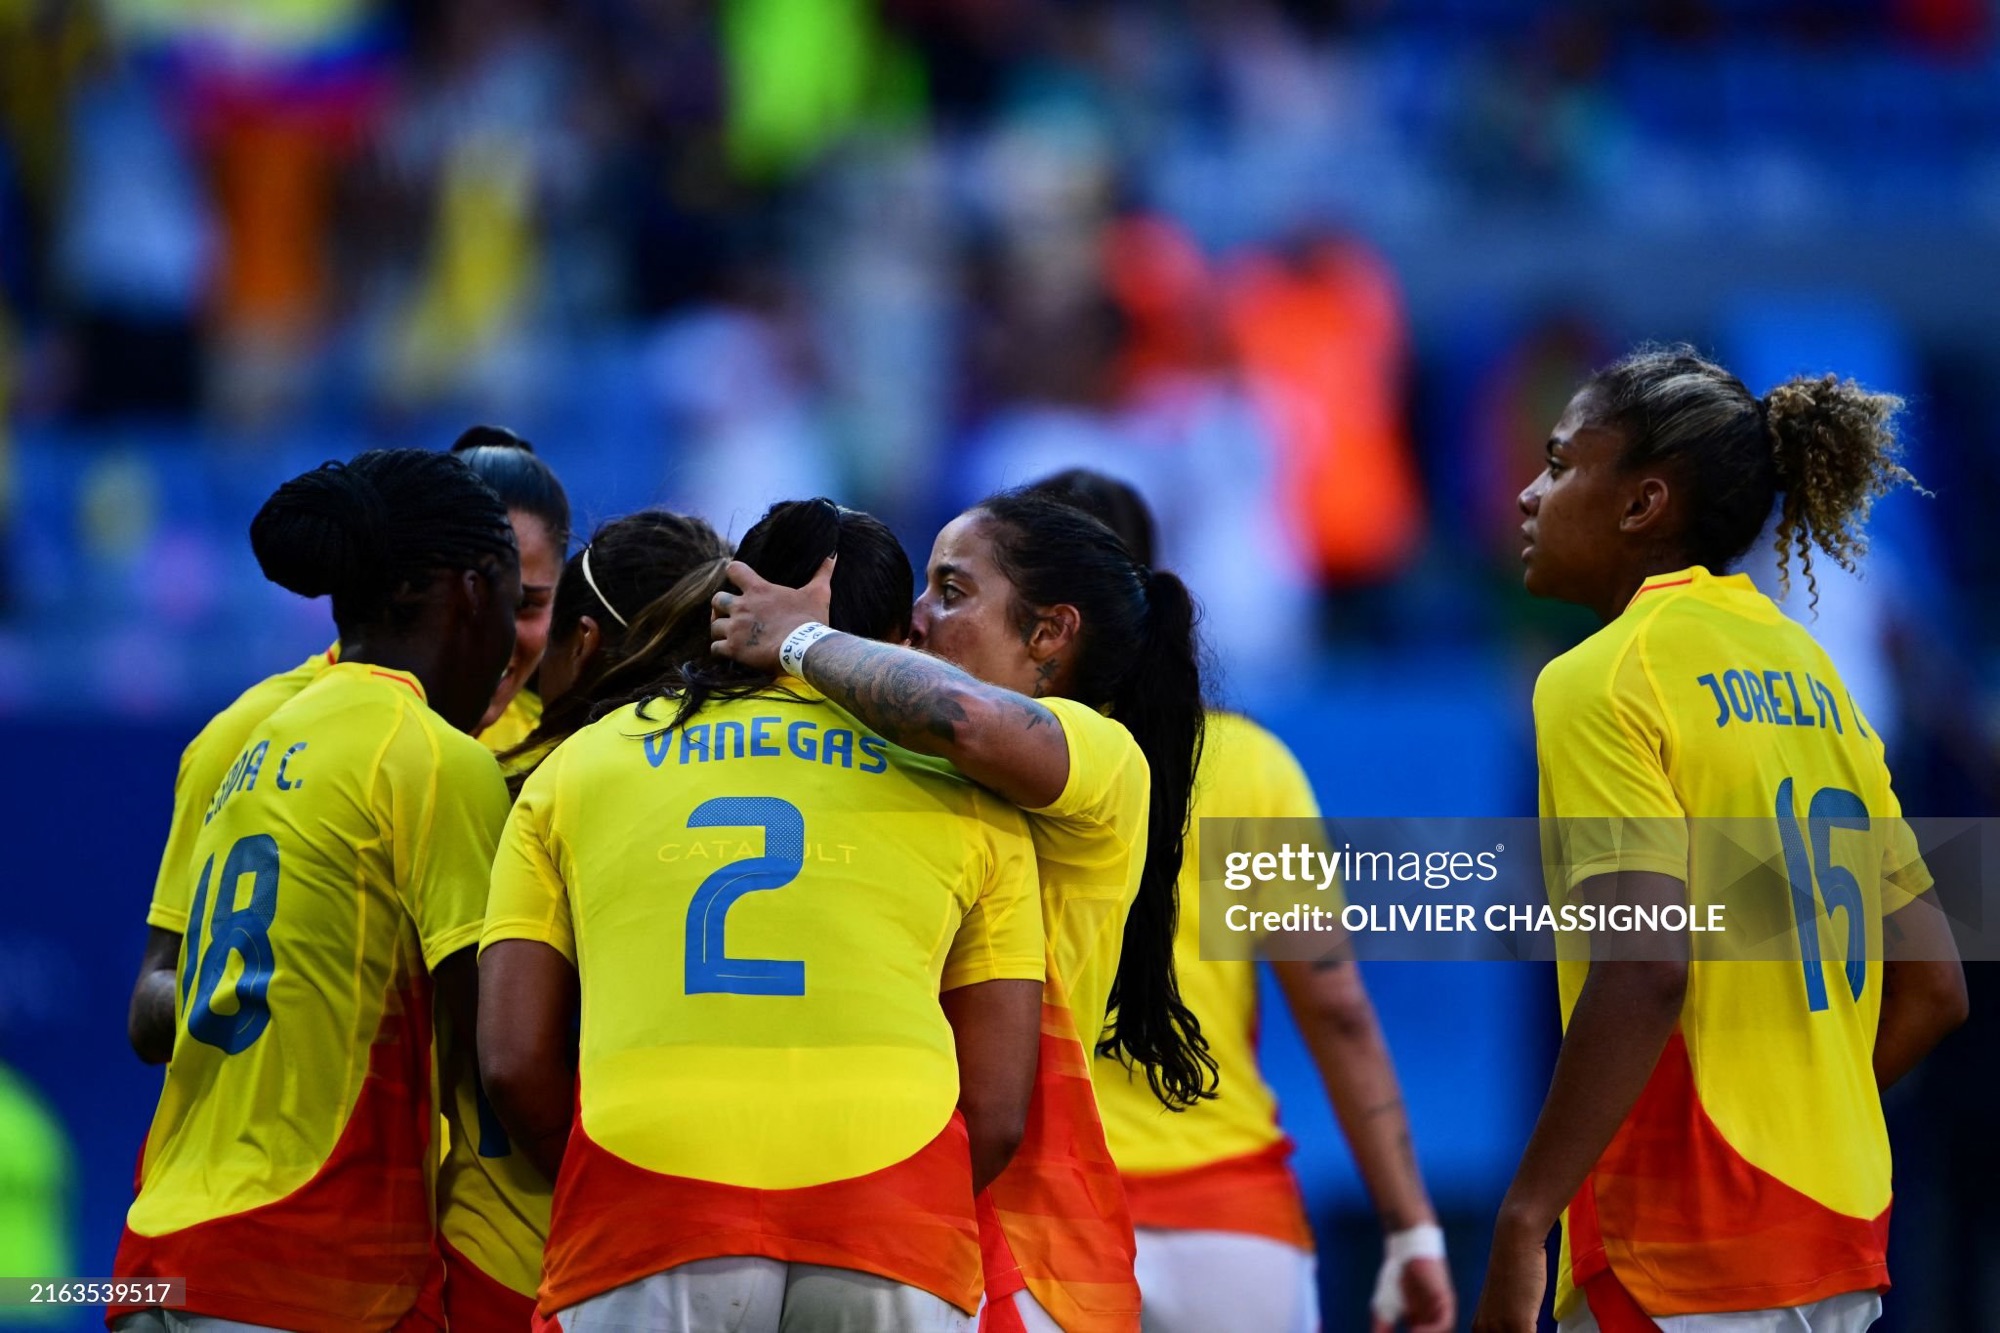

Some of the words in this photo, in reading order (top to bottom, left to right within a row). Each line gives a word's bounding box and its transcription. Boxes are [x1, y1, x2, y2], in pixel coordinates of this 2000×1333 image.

[1696, 669, 1843, 735] JORELYN
[276, 742, 307, 791] C.
[643, 717, 888, 774] VANEGAS
[657, 840, 858, 864] CATALT
[685, 796, 805, 996] 2
[1775, 777, 1870, 1012] 15
[181, 834, 280, 1056] 18
